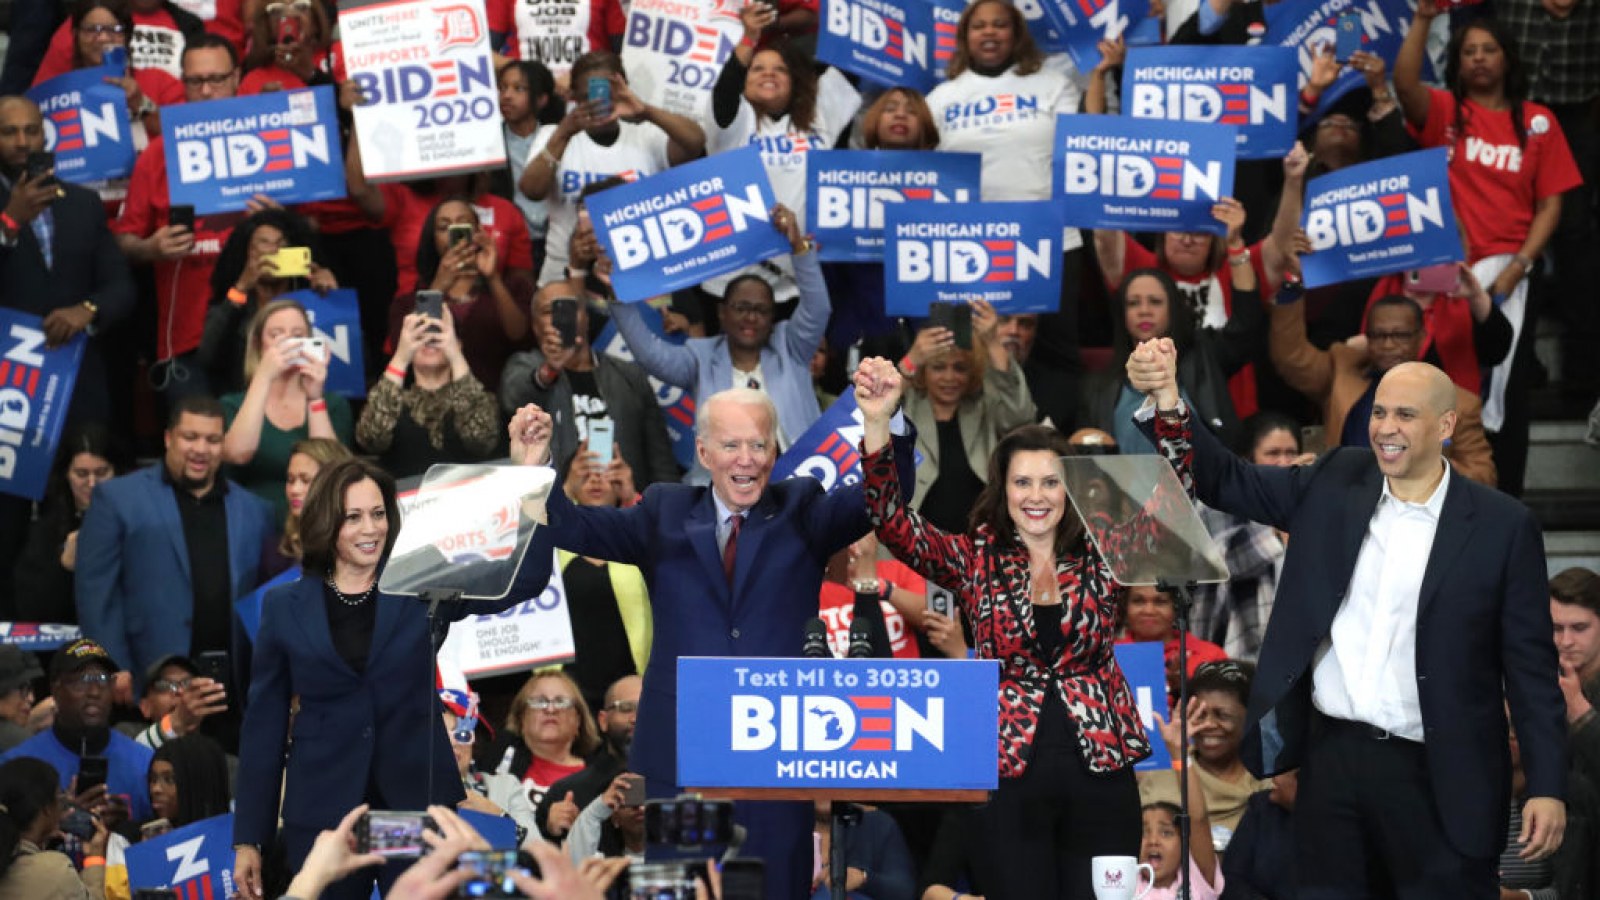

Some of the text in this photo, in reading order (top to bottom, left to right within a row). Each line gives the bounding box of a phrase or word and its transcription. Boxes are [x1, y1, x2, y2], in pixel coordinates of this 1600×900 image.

[529, 7, 576, 16] JOB
[827, 0, 929, 71] BIDEN
[348, 44, 430, 70] SUPPORTS
[1134, 66, 1255, 82] MICHIGAN FOR
[352, 55, 492, 107] BIDEN
[667, 60, 717, 90] 202
[413, 96, 495, 128] 2020
[943, 93, 1037, 123] BIDEN
[1131, 83, 1287, 126] BIDEN
[174, 115, 258, 139] MICHIGAN
[177, 124, 331, 184] BIDEN
[1066, 135, 1190, 156] MICHIGAN FOR
[1464, 137, 1523, 173] VOTE
[818, 170, 939, 186] MICHIGAN FOR
[1064, 152, 1222, 201] BIDEN
[1310, 174, 1411, 210] MICHIGAN FOR
[603, 176, 725, 228] MICHIGAN FOR
[1306, 187, 1445, 251] BIDEN
[607, 183, 770, 271] BIDEN
[897, 222, 1021, 238] MICHIGAN FOR
[896, 239, 1052, 283] BIDEN
[734, 668, 940, 688] Text MI to 30330
[731, 694, 945, 752] BIDEN
[776, 760, 898, 779] MICHIGAN
